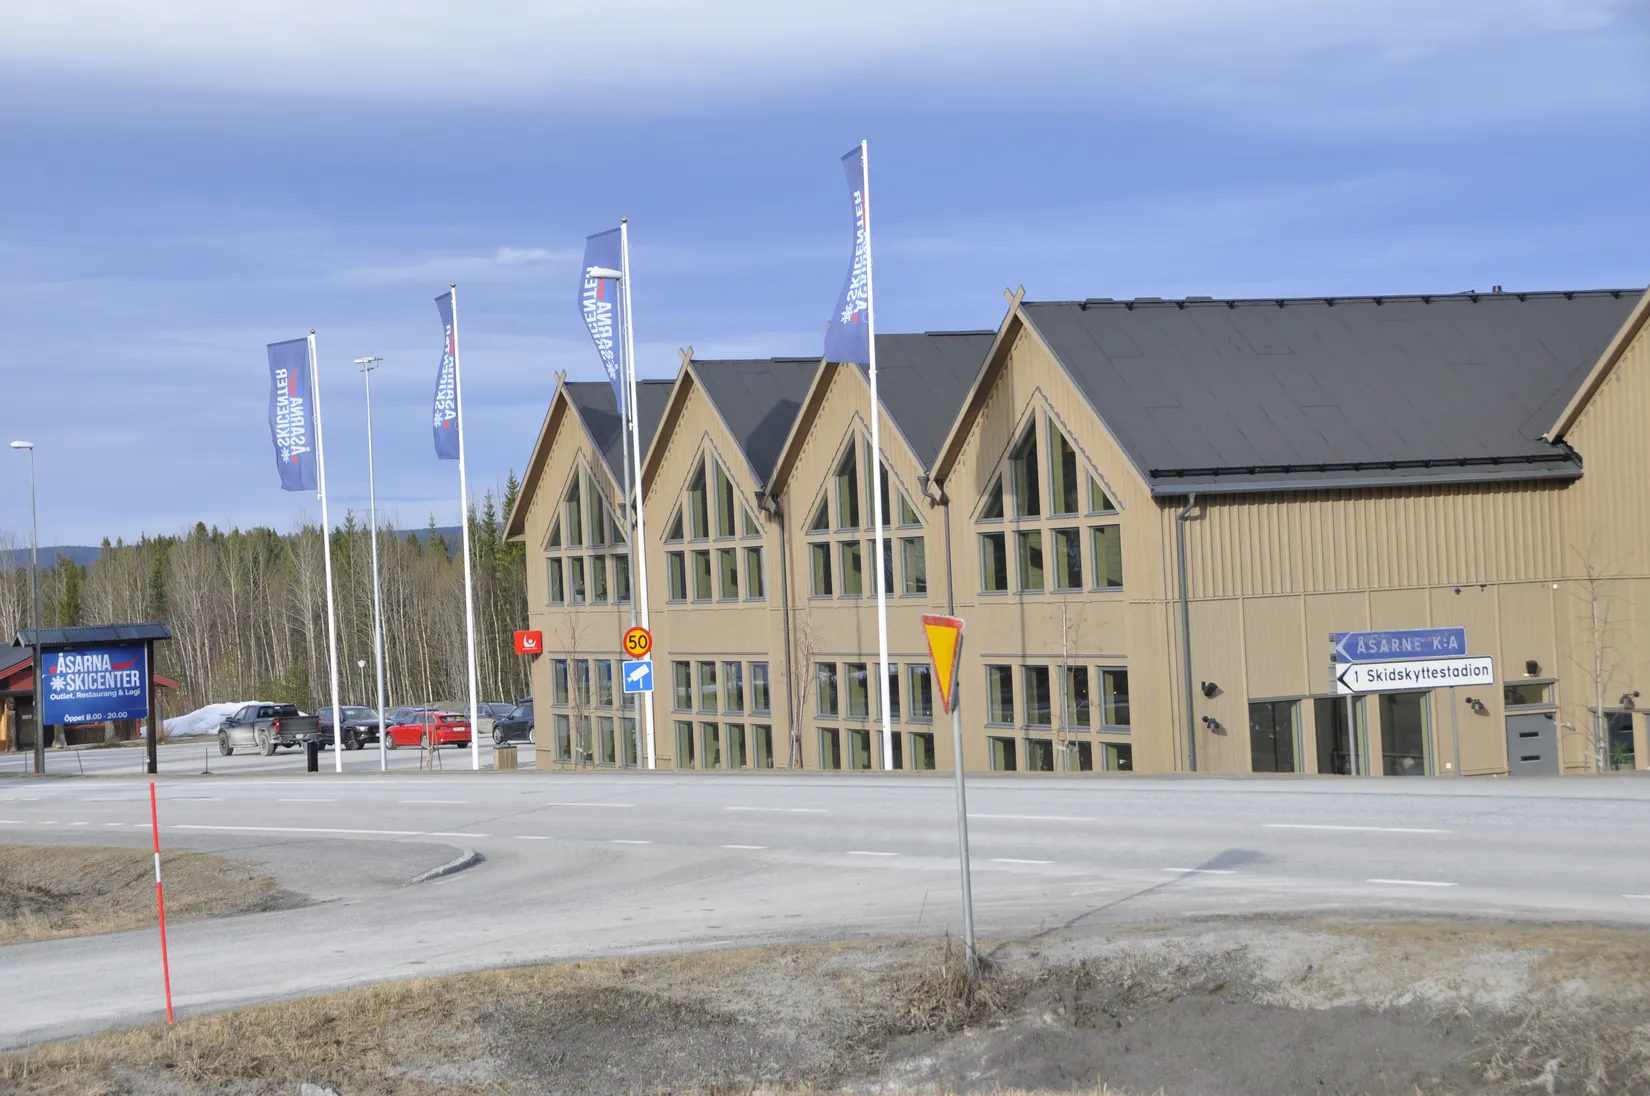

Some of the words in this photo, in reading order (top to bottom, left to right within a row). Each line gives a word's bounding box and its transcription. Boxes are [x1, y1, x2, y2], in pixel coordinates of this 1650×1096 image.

[628, 635, 648, 650] 50
[1356, 636, 1422, 654] ÅSARNE
[56, 652, 112, 674] ÅSARNA
[66, 670, 140, 691] SKICENTER
[1354, 670, 1359, 683] 1
[1367, 664, 1489, 683] Skidskyttestadion
[77, 690, 117, 698] Restaurang
[125, 688, 140, 697] Logi
[64, 713, 85, 723] Öppet
[86, 712, 102, 721] 8.00
[107, 711, 128, 719] 20.00
